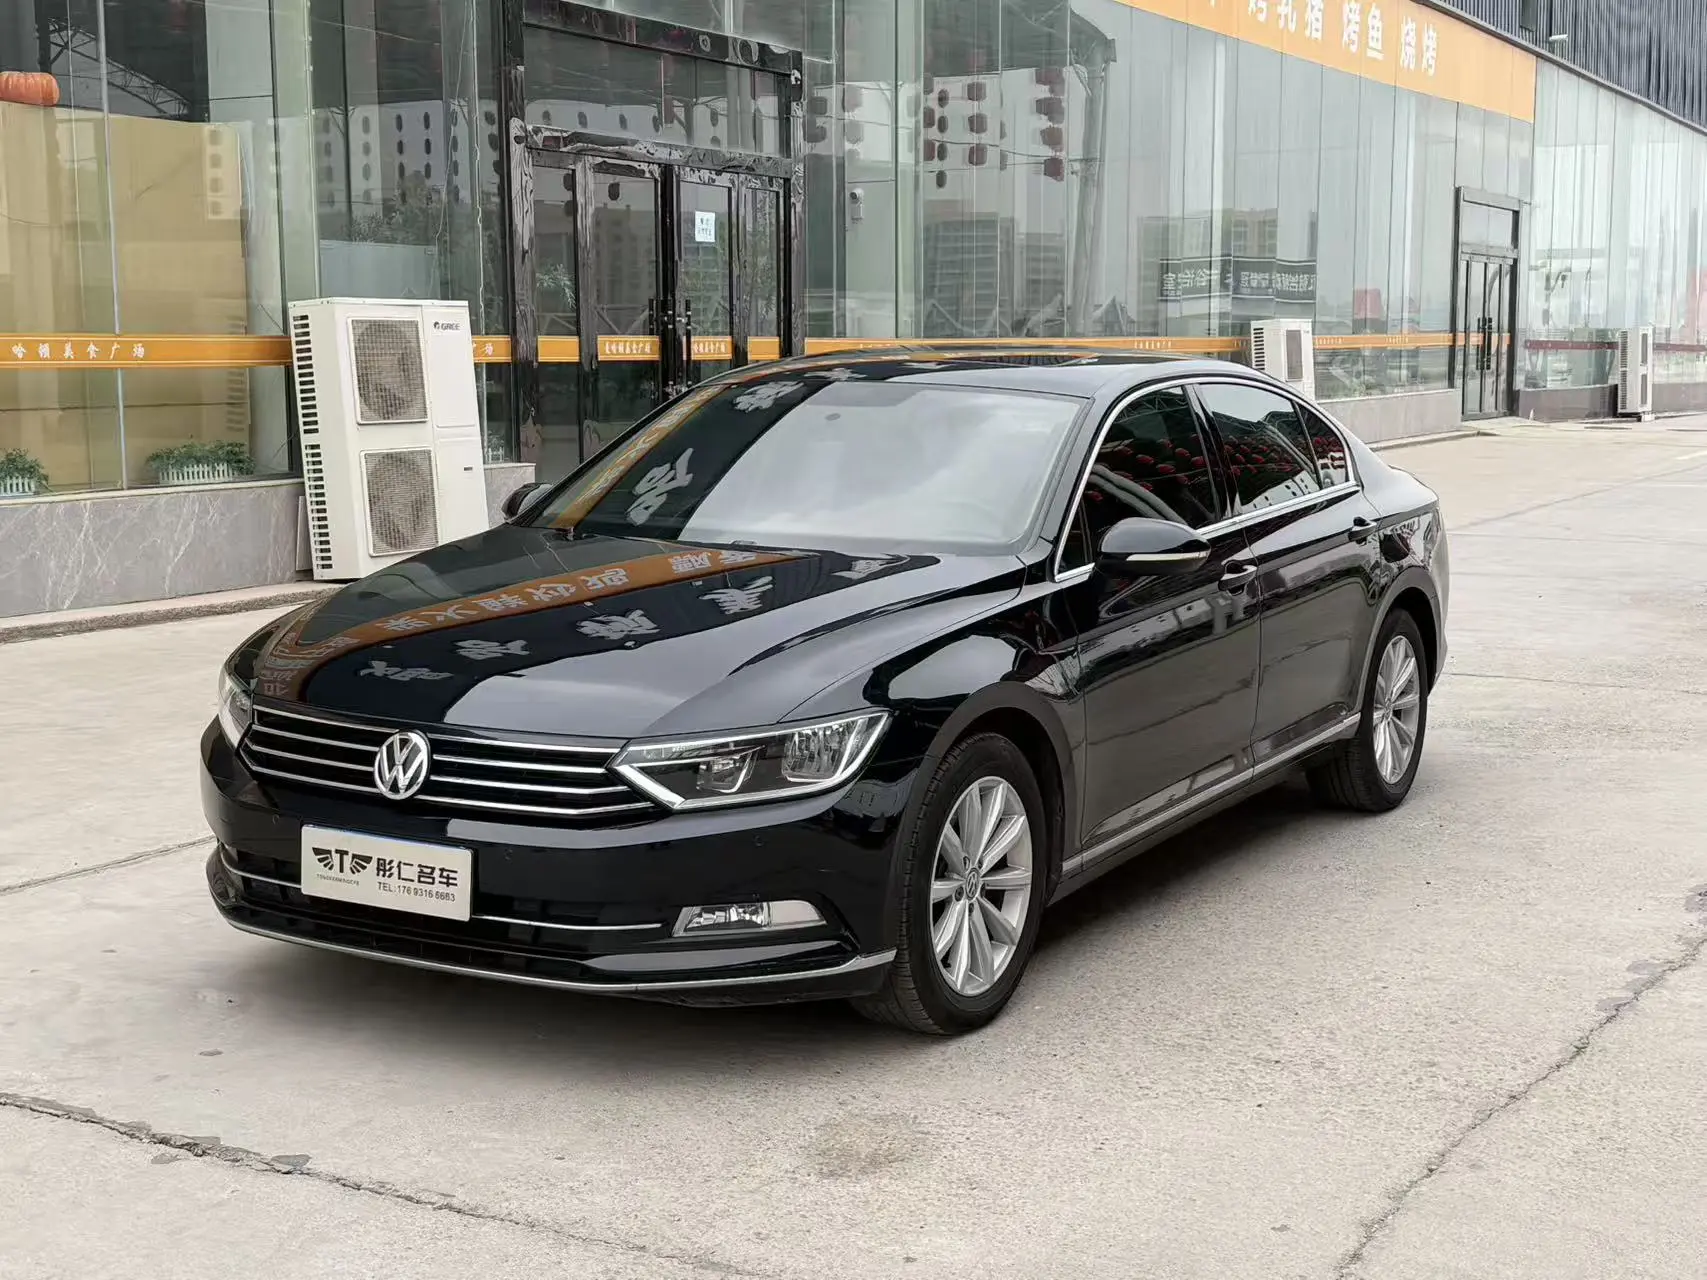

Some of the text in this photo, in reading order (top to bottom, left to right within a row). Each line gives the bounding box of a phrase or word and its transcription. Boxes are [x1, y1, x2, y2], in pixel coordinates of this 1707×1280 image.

[1342, 1, 1385, 60] 烤鱼
[1400, 16, 1438, 76] 烧烤
[441, 323, 461, 331] GREE
[376, 858, 458, 888] 彤仁名车
